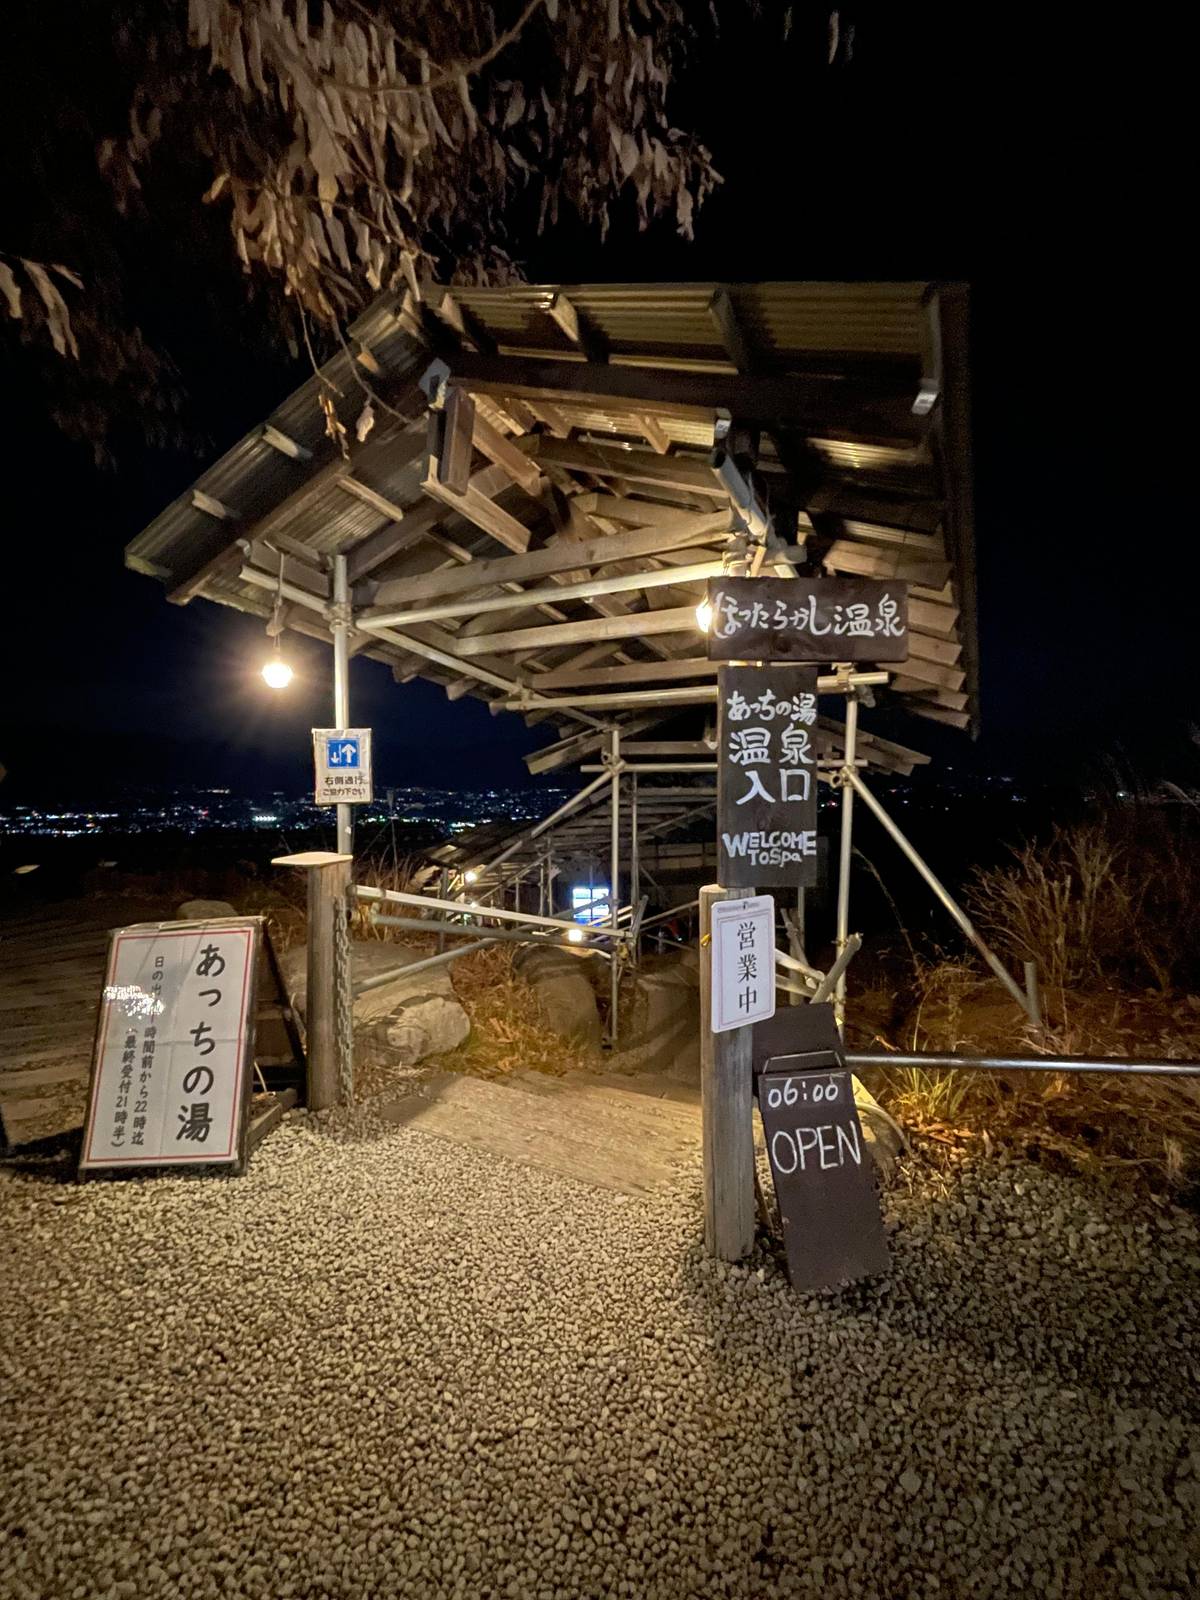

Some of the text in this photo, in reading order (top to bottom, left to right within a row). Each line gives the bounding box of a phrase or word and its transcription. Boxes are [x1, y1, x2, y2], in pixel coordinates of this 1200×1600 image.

[713, 591, 906, 639] ほったらかし温泉
[726, 688, 817, 725] あっちの湯
[728, 722, 815, 766] 温泉
[735, 768, 811, 805] 入口
[721, 830, 817, 858] WELCOME
[737, 920, 758, 1015] 営業中
[176, 944, 226, 1143] あっちの湯
[767, 1078, 839, 1108] 06:00
[771, 1120, 862, 1174] OPEN
